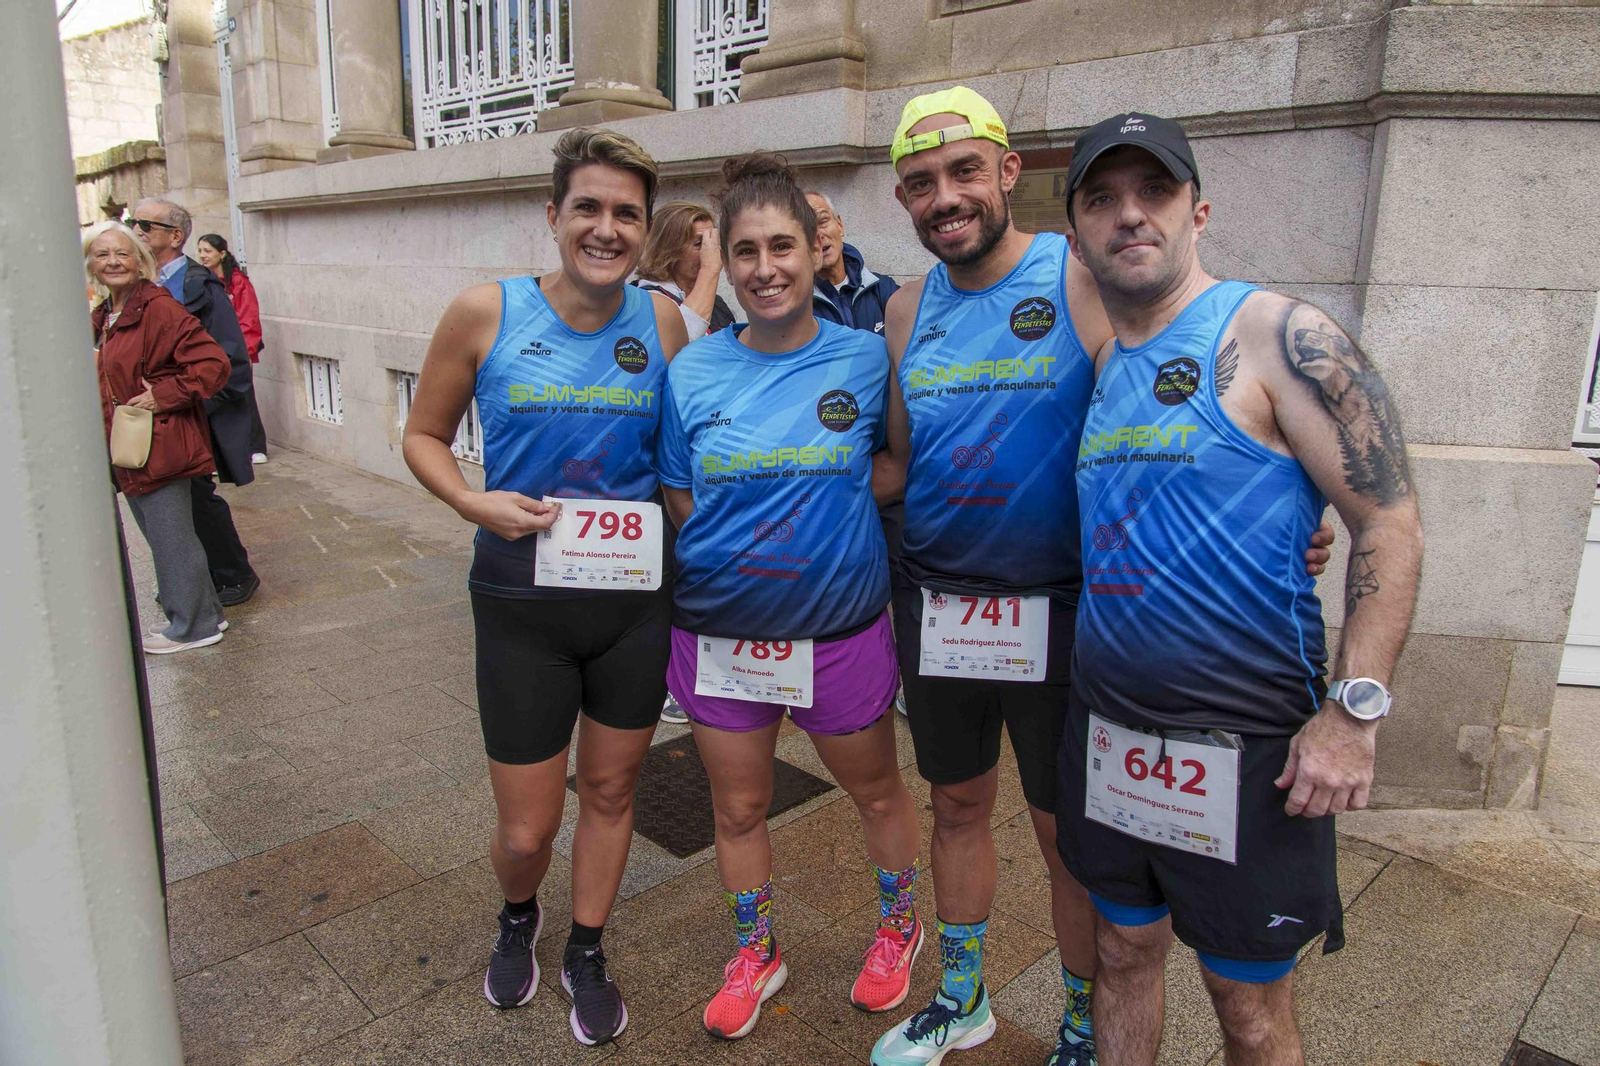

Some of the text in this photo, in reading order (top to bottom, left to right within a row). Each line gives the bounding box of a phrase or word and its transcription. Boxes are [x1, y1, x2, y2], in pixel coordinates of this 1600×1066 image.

[918, 329, 947, 344] amura
[520, 348, 551, 356] amura
[909, 356, 1057, 389] SUMYRENT
[509, 385, 655, 408] SUMYRENT
[908, 380, 1056, 401] alquiler y venta de maquinaria
[509, 405, 654, 419] alquiler y venta de maquinaria
[702, 446, 853, 474] SUMYRENT
[1117, 453, 1128, 463] de
[1130, 451, 1195, 464] maquinaria
[705, 466, 852, 485] alquiler y venta de maquinaria
[576, 511, 643, 540] 798
[561, 549, 637, 560] Fatima Alonso Pereira
[960, 596, 1021, 627] 741
[941, 637, 1022, 648] Sedu Rodriguez Alonso
[747, 669, 775, 677] Amoedo
[1124, 748, 1206, 797] 642
[1107, 784, 1126, 796] Oscar
[1127, 791, 1170, 811] Dominguez
[1171, 805, 1205, 818] Serrano
